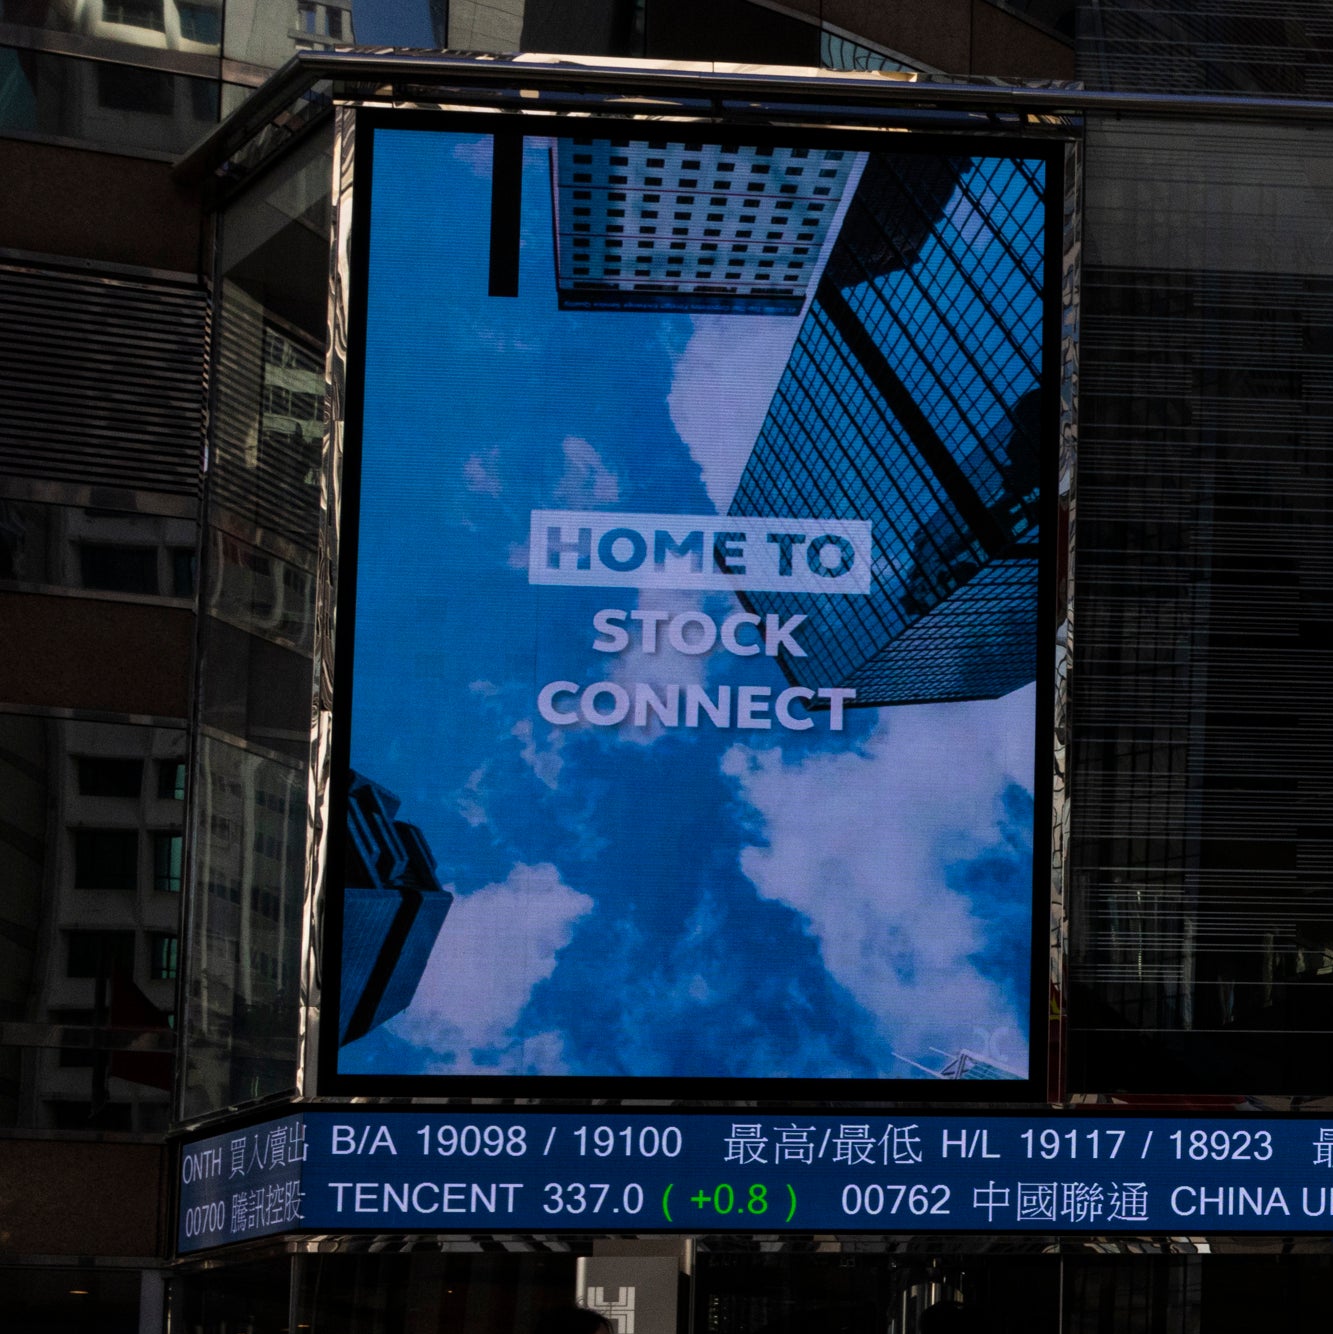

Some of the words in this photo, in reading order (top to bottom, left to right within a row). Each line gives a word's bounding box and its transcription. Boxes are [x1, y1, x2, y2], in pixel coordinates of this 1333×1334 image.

[546, 526, 748, 575] HOME
[766, 533, 856, 578] TO
[592, 608, 808, 658] STOCK
[536, 680, 857, 731] CONNECT
[331, 1125, 398, 1155] B/A
[417, 1124, 527, 1157] 19098
[573, 1125, 683, 1158] 19100
[723, 1122, 923, 1166] 最高/最低
[942, 1129, 1001, 1159] H/L
[1020, 1128, 1126, 1160] 19117
[1169, 1129, 1273, 1161] 18923
[185, 1200, 226, 1238] 00700
[327, 1182, 524, 1214] TENCENT
[543, 1182, 644, 1214] 337.0
[841, 1183, 951, 1215] 00762
[973, 1180, 1149, 1223] 中國聯通
[1170, 1185, 1291, 1217] CHINA
